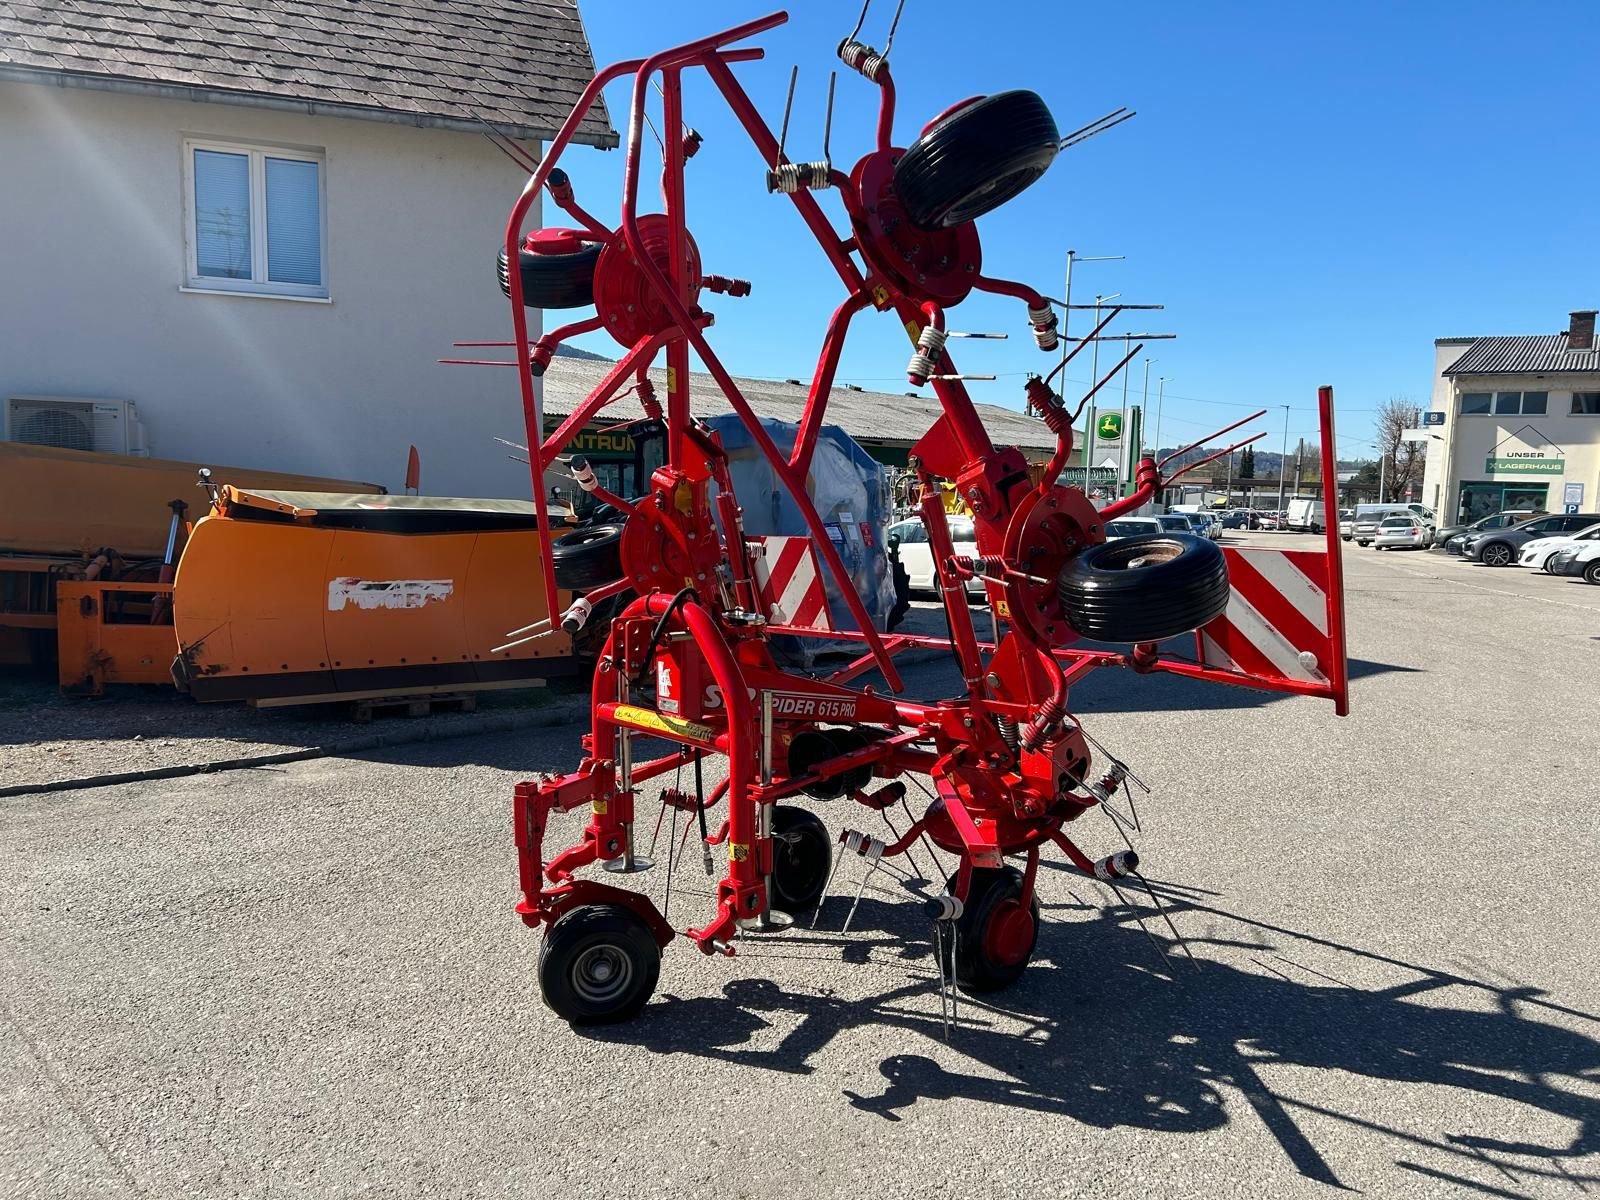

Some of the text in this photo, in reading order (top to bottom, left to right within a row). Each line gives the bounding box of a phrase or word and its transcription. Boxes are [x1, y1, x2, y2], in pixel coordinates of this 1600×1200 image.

[543, 432, 636, 451] NTRU
[1569, 505, 1577, 514] P
[758, 697, 856, 718] PIDER 615 PRO
